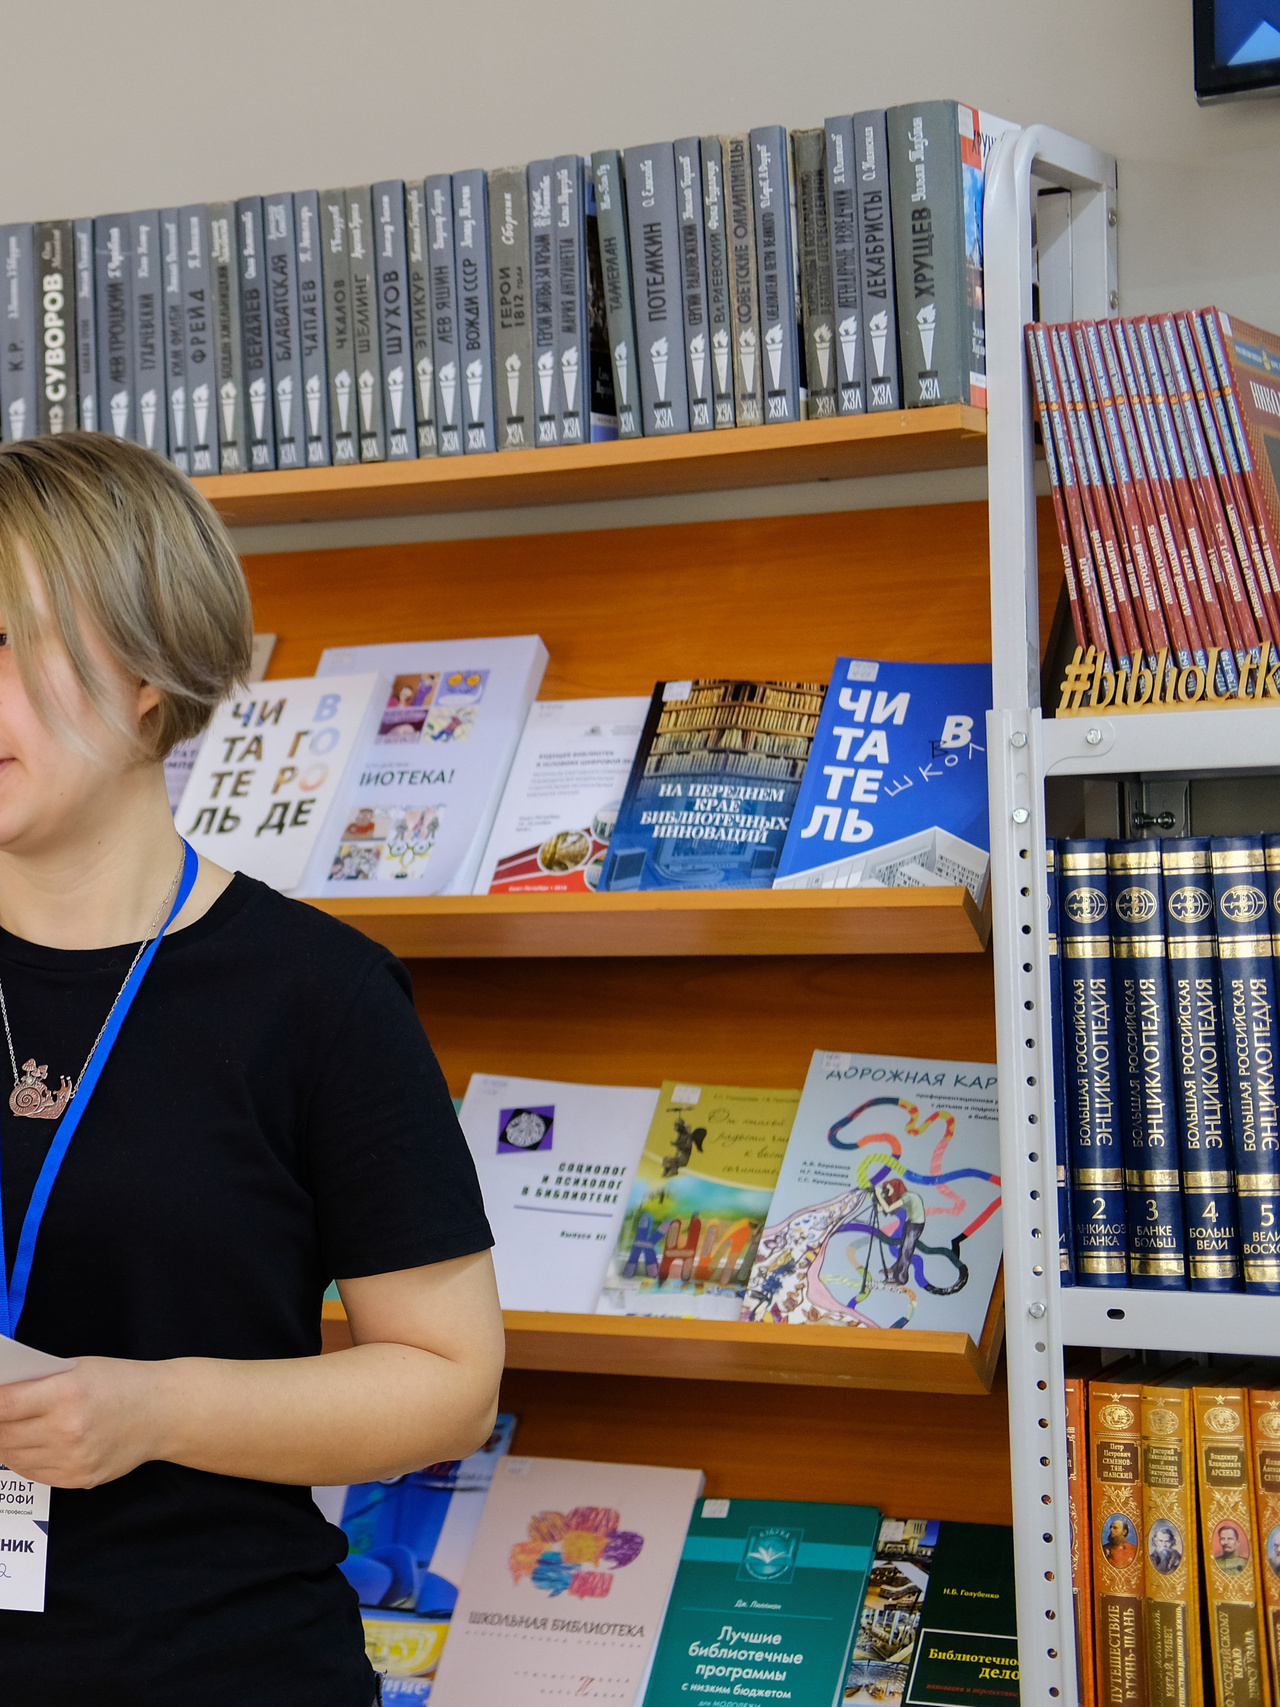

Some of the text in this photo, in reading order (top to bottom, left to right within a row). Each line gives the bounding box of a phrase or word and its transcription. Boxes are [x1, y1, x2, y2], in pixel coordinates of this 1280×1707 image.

[501, 192, 516, 245] Сборник
[730, 141, 751, 323] СОВЕТСКИЕ ОЛИМПИЙЦЫ
[863, 190, 886, 299] ДЕКАБРИСТЫ
[912, 207, 935, 299] ХРУЩЕВ
[535, 234, 553, 347] ГЕРОИ БИТВЫ ЗА КРЫМ
[559, 237, 576, 334] МАРИЯ АНТУАНЕТТА
[604, 237, 622, 313] ТАМЕРЛАН
[644, 222, 667, 322] ПОТЕМКИН
[272, 254, 291, 361] БЛАВАТСКАЯ
[333, 279, 346, 349] ЧКАЛОВ
[355, 274, 370, 353] ШЕЛЛИНГ
[384, 270, 402, 355] ШУХОВ
[412, 271, 427, 349] ЭПИКУР
[434, 266, 452, 344] ЛЕВ ЯШИН
[463, 258, 480, 350] ВОЖДИ СССР
[499, 266, 512, 329] ГЕРОИ
[513, 294, 525, 327] 1812
[43, 273, 67, 401] СУВОРОВ
[106, 282, 125, 383] ЛЕВ ТРОЦКИЙ
[138, 293, 155, 370] ТУХАЧЕВСКИЙ
[187, 288, 206, 363] ФРЕЙД
[244, 288, 264, 370] БЕРДЯЕВ
[302, 280, 317, 357] ЧАПАЕВ
[842, 391, 862, 408] ЖЗЛ
[872, 385, 892, 404] ЖЗЛ
[918, 378, 940, 398] ЖЗЛ
[653, 409, 674, 427] ЖЗЛ
[769, 398, 788, 416] ЖЗЛ
[1078, 557, 1092, 586] ОЛЬГА
[1090, 529, 1117, 612] ВЛАДИМИР СВЯТОЙ
[1132, 542, 1157, 611] ИВАН ГРОЗНЫЙ
[1146, 524, 1173, 605] МИХАИЛ РОМАНОВ
[1158, 512, 1191, 616] АЛЕКСЕЙ МИХАЙЛОВИЧ
[1208, 553, 1222, 583] ПАВЕЛ
[1222, 548, 1242, 602] АЛЕКСАНДР
[1252, 549, 1271, 594] НИКОЛАЙ
[1064, 567, 1079, 600] ВЕЩИЙ
[232, 699, 287, 728] ЧИ
[839, 687, 911, 725] ЧИ
[223, 735, 263, 763] ТА
[833, 715, 973, 764] ТА В
[210, 770, 255, 798] ТЕ
[658, 784, 785, 802] НА ПЕРЕДНЕМ
[823, 766, 884, 803] ТЕ
[186, 798, 316, 837] ЛЬ ДЕ
[640, 811, 790, 830] БИБЛИОТЕЧНЫХ
[693, 798, 741, 813] КРАЕ
[801, 805, 873, 843] ЛЬ
[652, 825, 769, 844] ИННОВАЦИЙ
[826, 1066, 945, 1086] ДОРОЖНАЯ
[1073, 979, 1091, 1146] БОЛЬШАЯ РОССИЙСКАЯ
[1090, 978, 1113, 1146] ЭНЦИКЛОПЕДИЯ
[1124, 979, 1144, 1147] БОЛЬШАЯ РОССИЙСКАЯ
[1139, 978, 1165, 1147] ЭНЦИКЛОПЕДИЯ
[1177, 979, 1200, 1149] БОЛЬШАЯ РОССИЙСКАЯ
[1196, 978, 1223, 1148] ЭНЦИКЛОПЕДИЯ
[1231, 979, 1256, 1151] БОЛЬШАЯ РОССИЙСКАЯ
[1250, 978, 1280, 1150] ЭНЦИКЛОПЕДИЯ
[542, 1175, 622, 1190] И ПСИХОЛОГ
[559, 1162, 627, 1176] СОЦИОЛОГ
[522, 1187, 619, 1204] В БИБЛИОТЕКЕ
[1092, 1197, 1106, 1219] 2
[1146, 1199, 1159, 1221] 3
[1202, 1201, 1218, 1222] 4
[1137, 1226, 1172, 1236] БАНКЕ
[1189, 1227, 1234, 1238] БОЛЬШ
[1261, 1204, 1274, 1226] 5
[1083, 1236, 1119, 1246] БАНКА
[1134, 1237, 1176, 1248] БОЛЬШ
[1197, 1240, 1228, 1250] ВЕЛИ
[1110, 1443, 1124, 1451] Петр
[1211, 1453, 1238, 1461] Владимир
[1103, 1471, 1133, 1479] ШАНСКИЙ
[1211, 1469, 1240, 1477] АРСЕНЬЕВ
[943, 1588, 999, 1599] Н.Б. Голубенко
[469, 1611, 645, 1638] ШКОЛЬНАЯ БИБЛИОТЕКА
[717, 1626, 782, 1645] Лучшие
[688, 1641, 804, 1664] библиотечные
[928, 1648, 1020, 1666] Библиотечно
[1108, 1605, 1123, 1703] ПУТЕШЕСТВИЕ
[1123, 1608, 1137, 1689] ТЯНЬ-ШАНЬ
[1164, 1627, 1175, 1697] КИТАЙ. ТИБЕТ
[1219, 1611, 1234, 1696] УССУРИЙСКОМУ
[1232, 1648, 1243, 1678] КРАЮ
[1244, 1631, 1257, 1663] УЗАЛА
[691, 1683, 730, 1694] низким
[733, 1684, 791, 1699] бюджетом
[695, 1664, 787, 1681] программы
[979, 1667, 1020, 1680] дело
